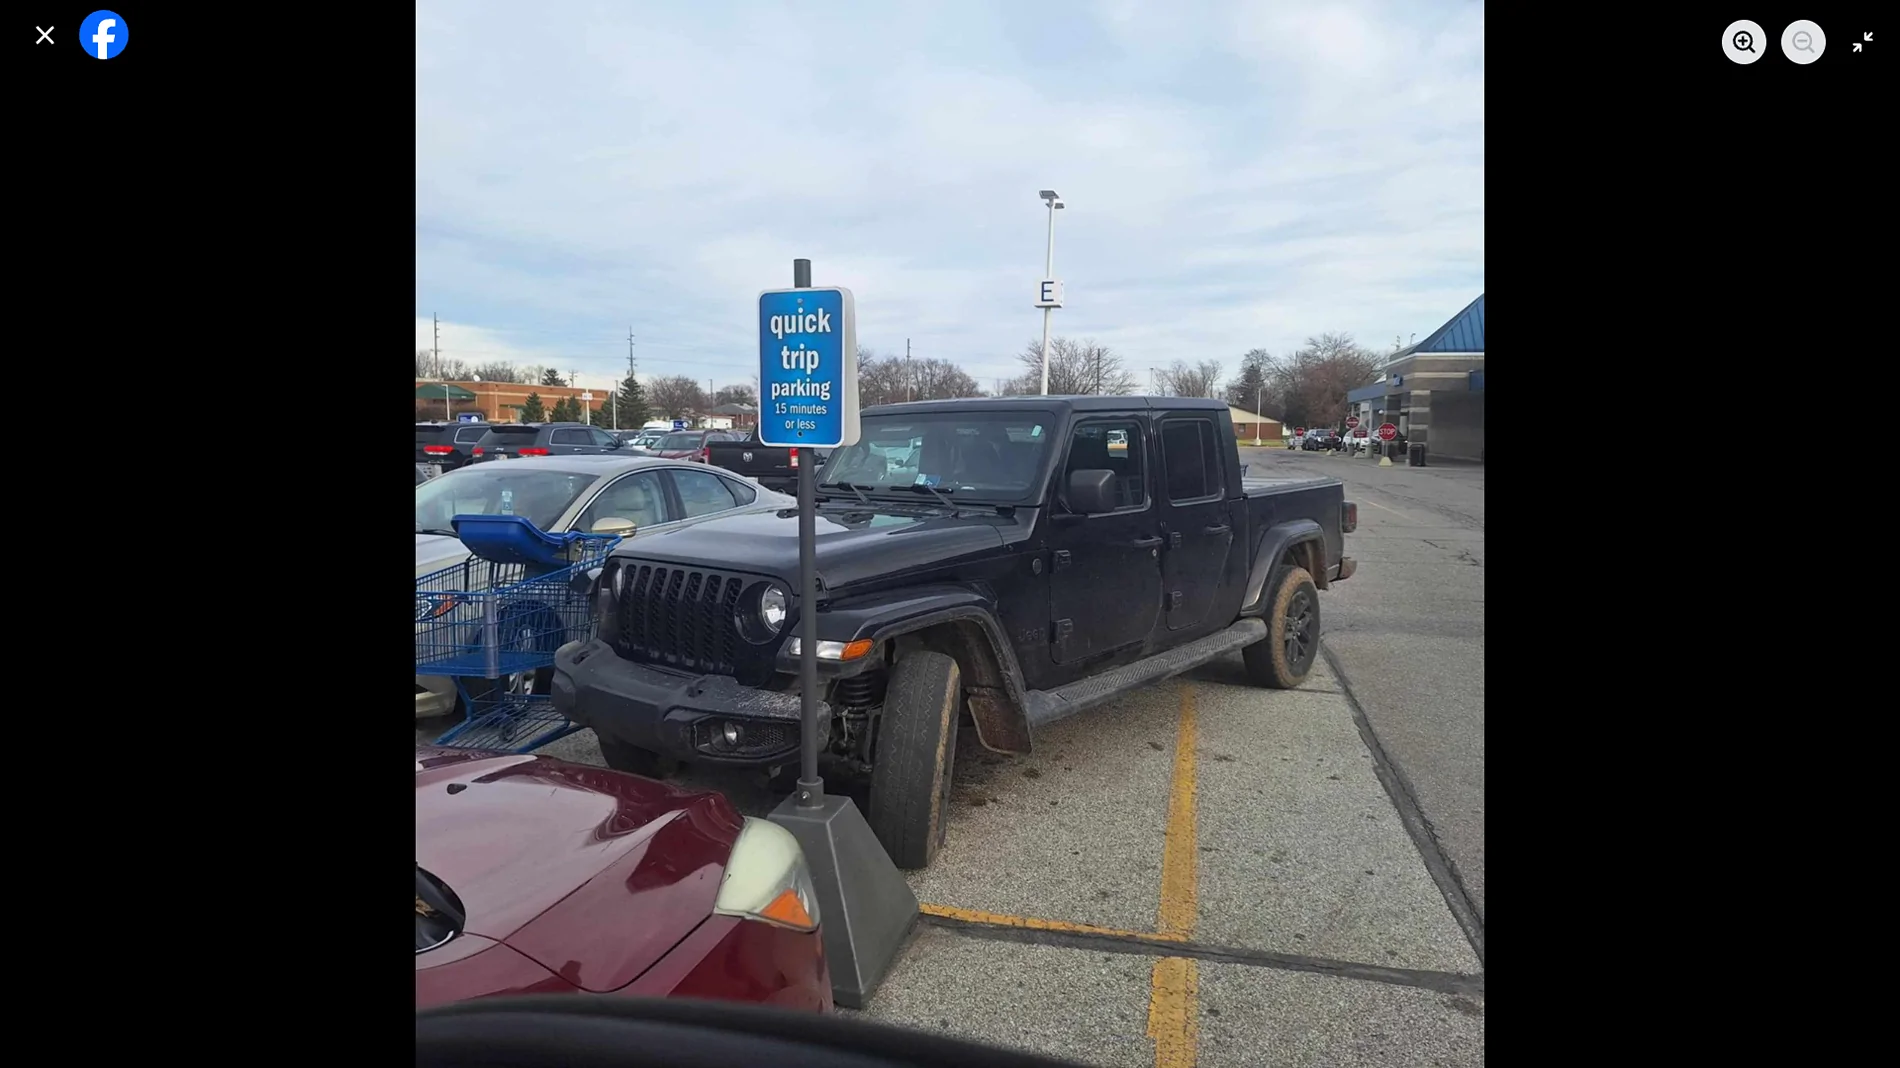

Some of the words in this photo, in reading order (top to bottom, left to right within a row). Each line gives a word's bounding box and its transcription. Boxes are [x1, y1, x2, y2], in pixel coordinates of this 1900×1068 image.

[1041, 281, 1054, 302] E
[770, 307, 831, 339] quick
[781, 343, 819, 374] trip
[771, 377, 831, 400] parking
[775, 403, 787, 414] 15
[790, 403, 827, 414] minutes
[785, 420, 795, 429] or
[797, 418, 816, 429] less
